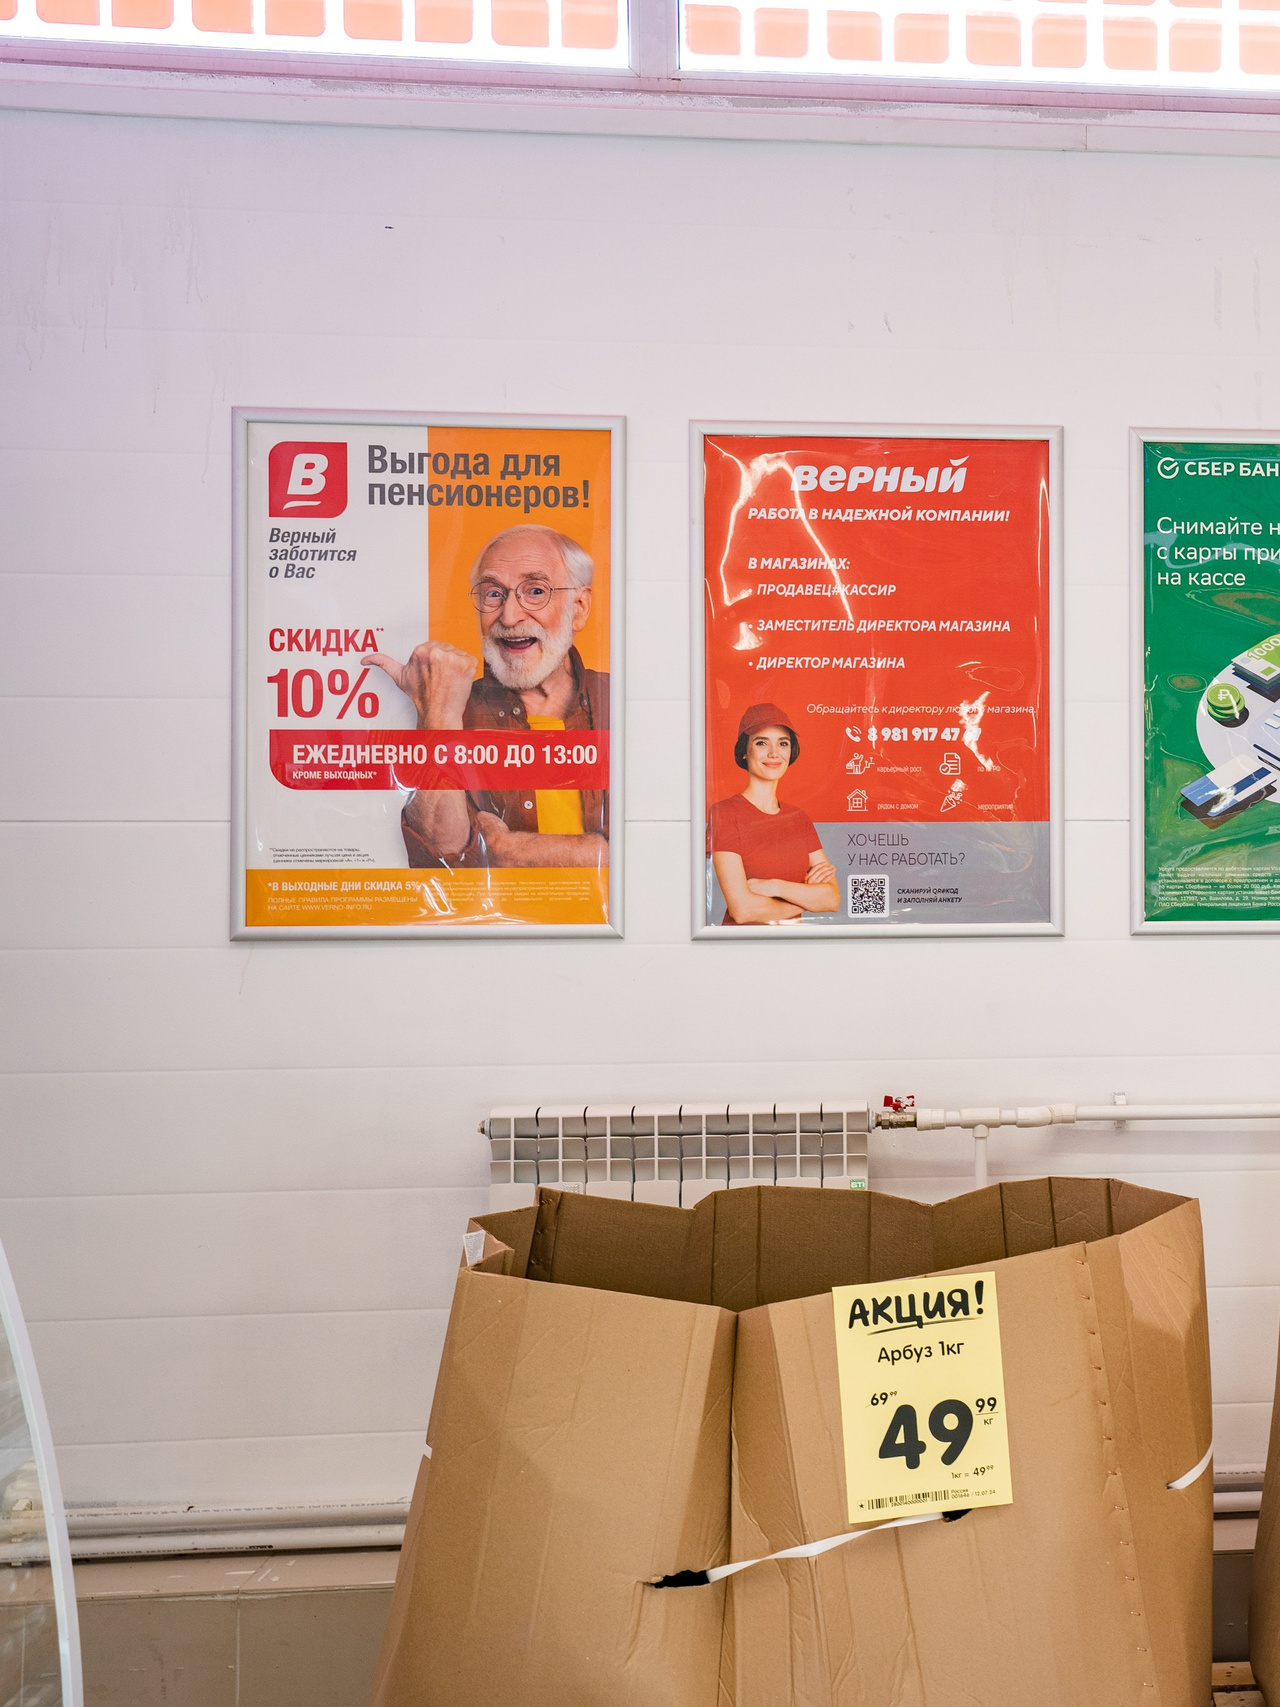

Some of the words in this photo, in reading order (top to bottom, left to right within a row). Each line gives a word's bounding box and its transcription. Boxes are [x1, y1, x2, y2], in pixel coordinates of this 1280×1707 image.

[367, 444, 490, 479] Выгода
[500, 452, 561, 480] для
[1184, 462, 1235, 477] СБЕР
[368, 479, 591, 514] пенсионеров!
[748, 507, 806, 521] РАБОТА
[809, 508, 818, 520] В
[821, 505, 913, 523] НАДЕЖНОЙ
[916, 509, 1010, 522] КОМПАНИИ!
[1157, 516, 1263, 536] Снимайте
[268, 527, 337, 545] Верный
[268, 544, 357, 562] заботится
[1157, 546, 1168, 560] с
[1174, 545, 1237, 564] карты
[748, 557, 758, 569] В
[760, 557, 850, 570] МАГАЗИНАХ:
[268, 566, 280, 579] о
[283, 564, 316, 579] Вас
[1157, 571, 1181, 586] на
[1188, 571, 1246, 587] кассе
[756, 620, 855, 632] ЗАМЕСТИТЕЛЬ
[856, 620, 937, 635] ДИРЕКТОРА
[938, 620, 1011, 632] МАГАЗИНА
[756, 656, 830, 671] ДИРЕКТОР
[832, 657, 905, 669] МАГАЗИНА
[267, 668, 380, 720] 10%
[806, 703, 880, 715] Обращайтесь
[888, 704, 944, 716] директору
[867, 727, 878, 742] 8
[881, 727, 908, 742] 981
[912, 727, 938, 742] 917
[940, 727, 960, 741] 47
[292, 744, 427, 767] ЕЖЕДНЕВНО
[433, 745, 448, 764] С
[454, 745, 498, 764] 8:00
[503, 745, 535, 768] ДО
[542, 745, 597, 764] 13:00
[292, 770, 322, 780] КРОМЕ
[847, 833, 909, 847] ХОЧЕШЬ
[847, 853, 856, 866] У
[858, 852, 888, 866] НАС
[891, 852, 966, 866] РАБОТАТЬ?
[282, 881, 338, 892] ВЫХОДНЫЕ
[340, 881, 362, 892] ДНИ
[364, 880, 403, 892] СКИДКА
[405, 880, 421, 891] 5%
[897, 886, 930, 895] СКАНИРУЙ
[902, 896, 937, 904] ЗАПОЛНЯЙ
[848, 1280, 985, 1329] АКЦИЯ!
[877, 1344, 933, 1366] Арбуз
[938, 1341, 965, 1356] 1кг
[870, 1391, 889, 1407] 69
[983, 1417, 994, 1426] кг
[878, 1398, 974, 1470] 49
[975, 1397, 997, 1414] 99
[951, 1471, 963, 1480] 1кг
[973, 1467, 986, 1477] 49
